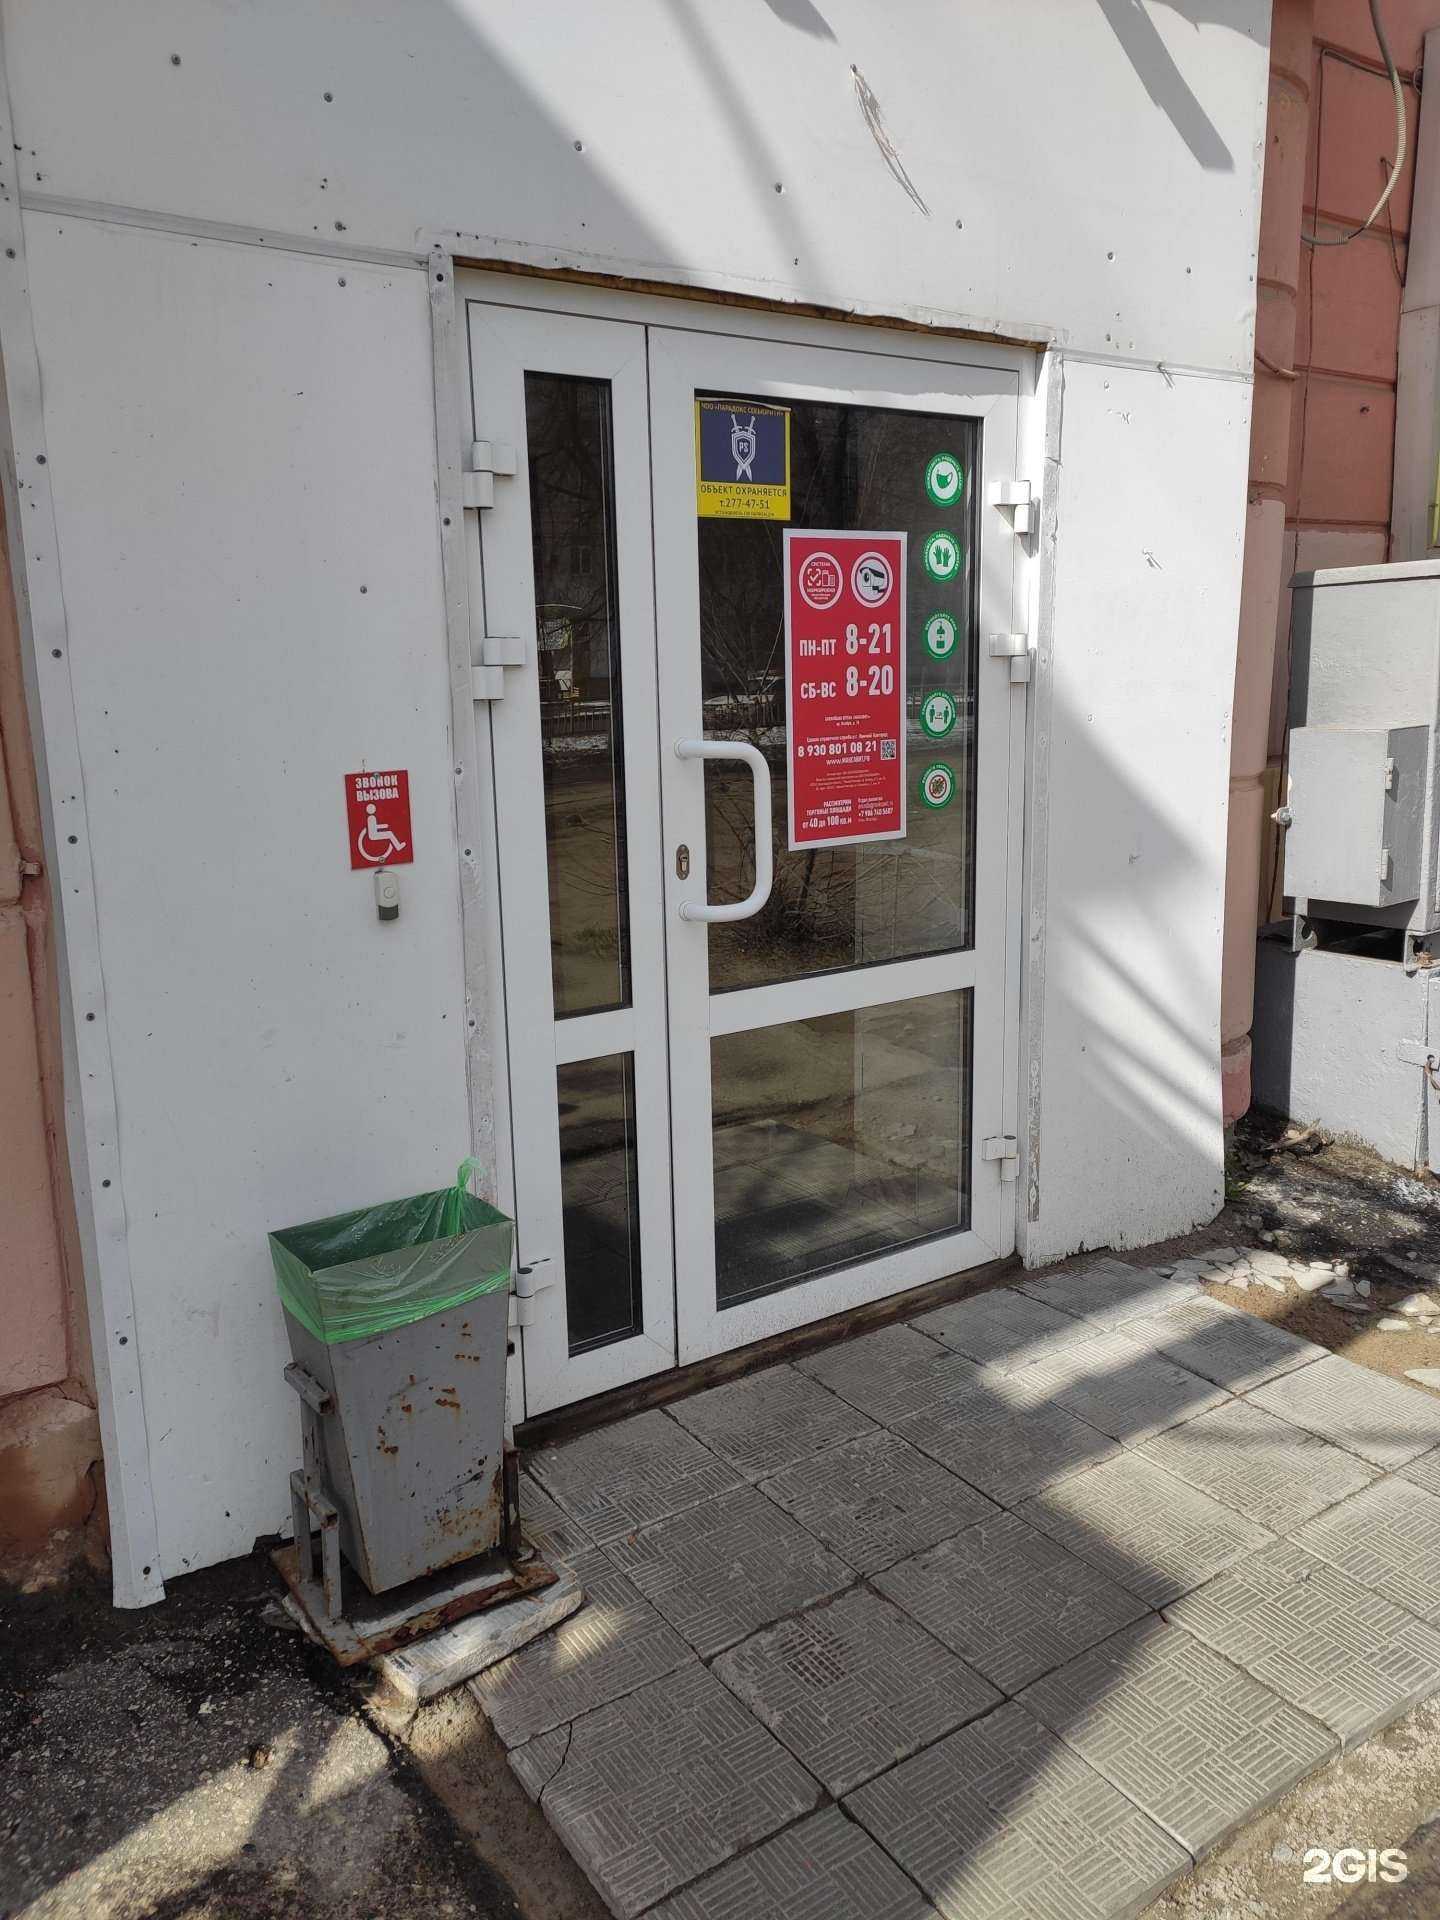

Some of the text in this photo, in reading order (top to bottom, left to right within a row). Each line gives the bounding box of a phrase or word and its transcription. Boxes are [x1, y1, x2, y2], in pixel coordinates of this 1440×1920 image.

[701, 484, 786, 497] ОБЪЕКТ ОХРАНЯЕТСЯ
[800, 623, 891, 656] ПН-ПТ 8-21
[801, 664, 894, 699] СБ-ВС 8-20
[797, 740, 877, 757] 8 930 801 08 21
[355, 775, 398, 789] ЗВОНОК
[356, 787, 399, 802] ВЫЗОВА
[809, 817, 818, 828] 40
[827, 815, 839, 826] 100
